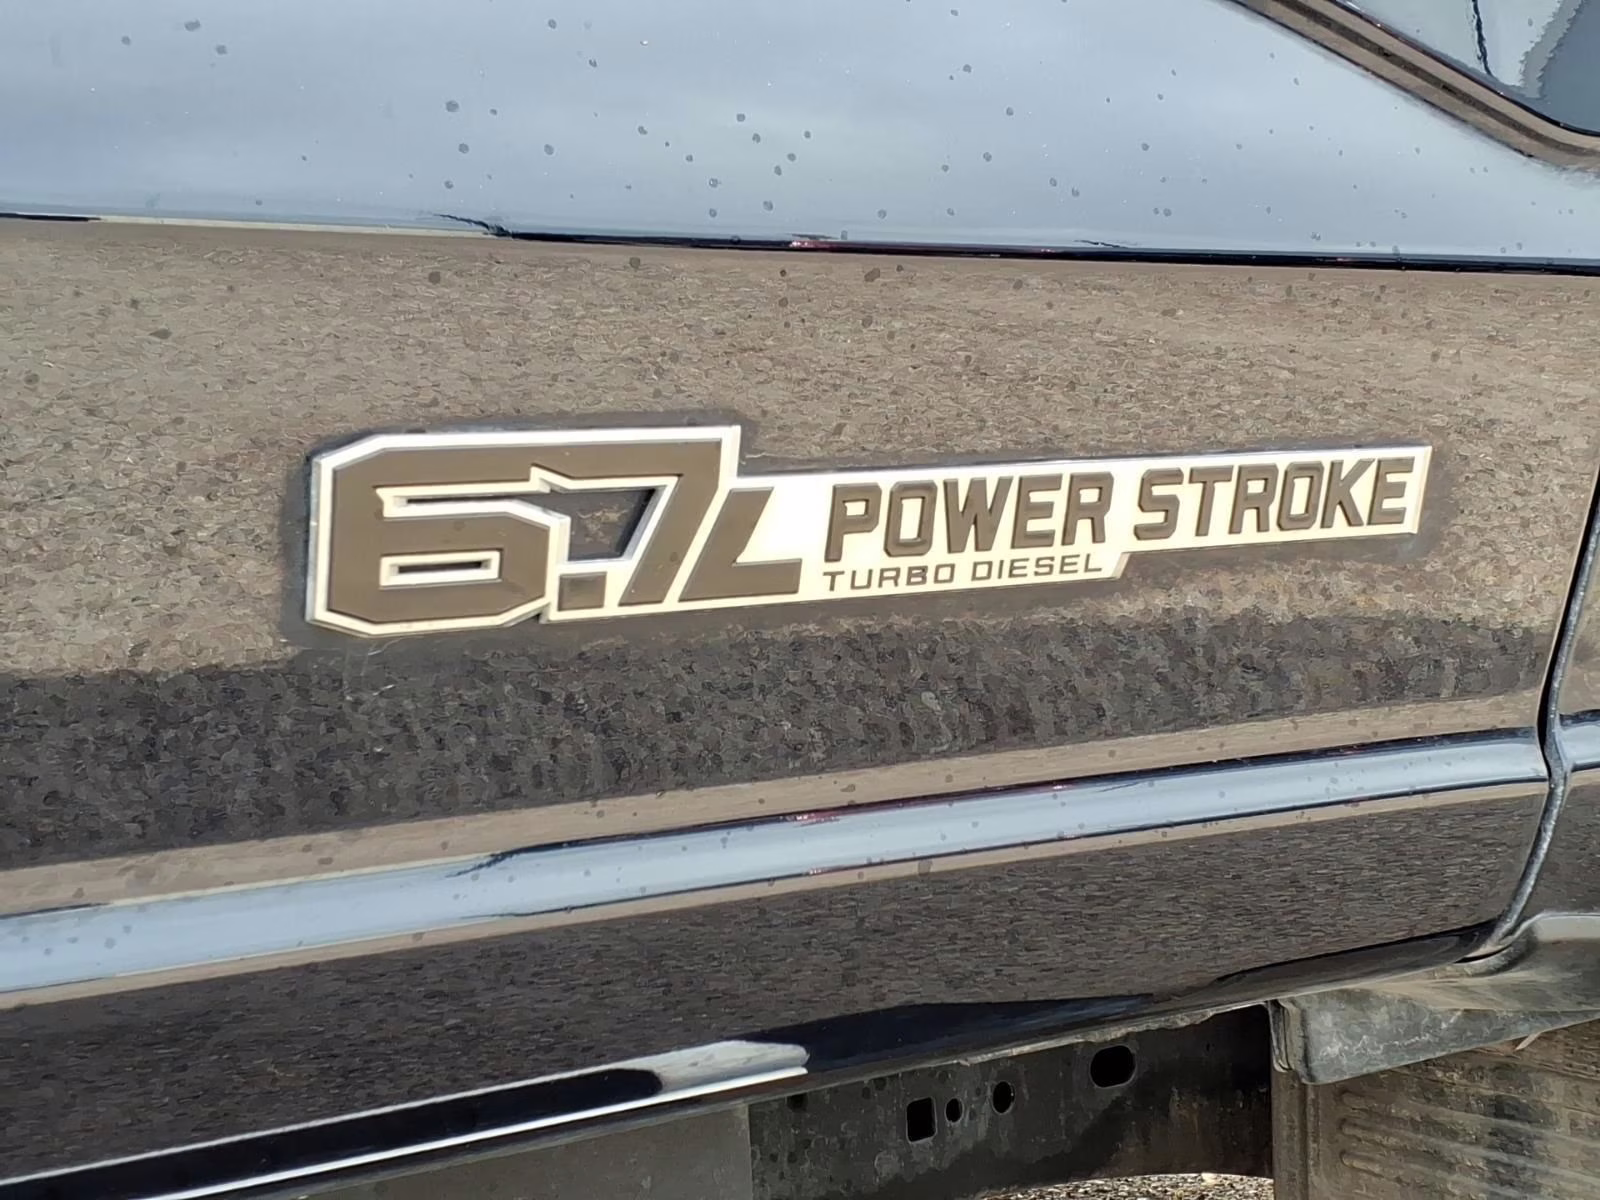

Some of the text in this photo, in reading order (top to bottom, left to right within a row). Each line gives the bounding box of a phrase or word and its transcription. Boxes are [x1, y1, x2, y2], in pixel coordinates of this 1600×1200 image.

[326, 439, 1415, 623] 6.7L POWER STROKE
[822, 553, 1102, 592] TURBO DIESEL
